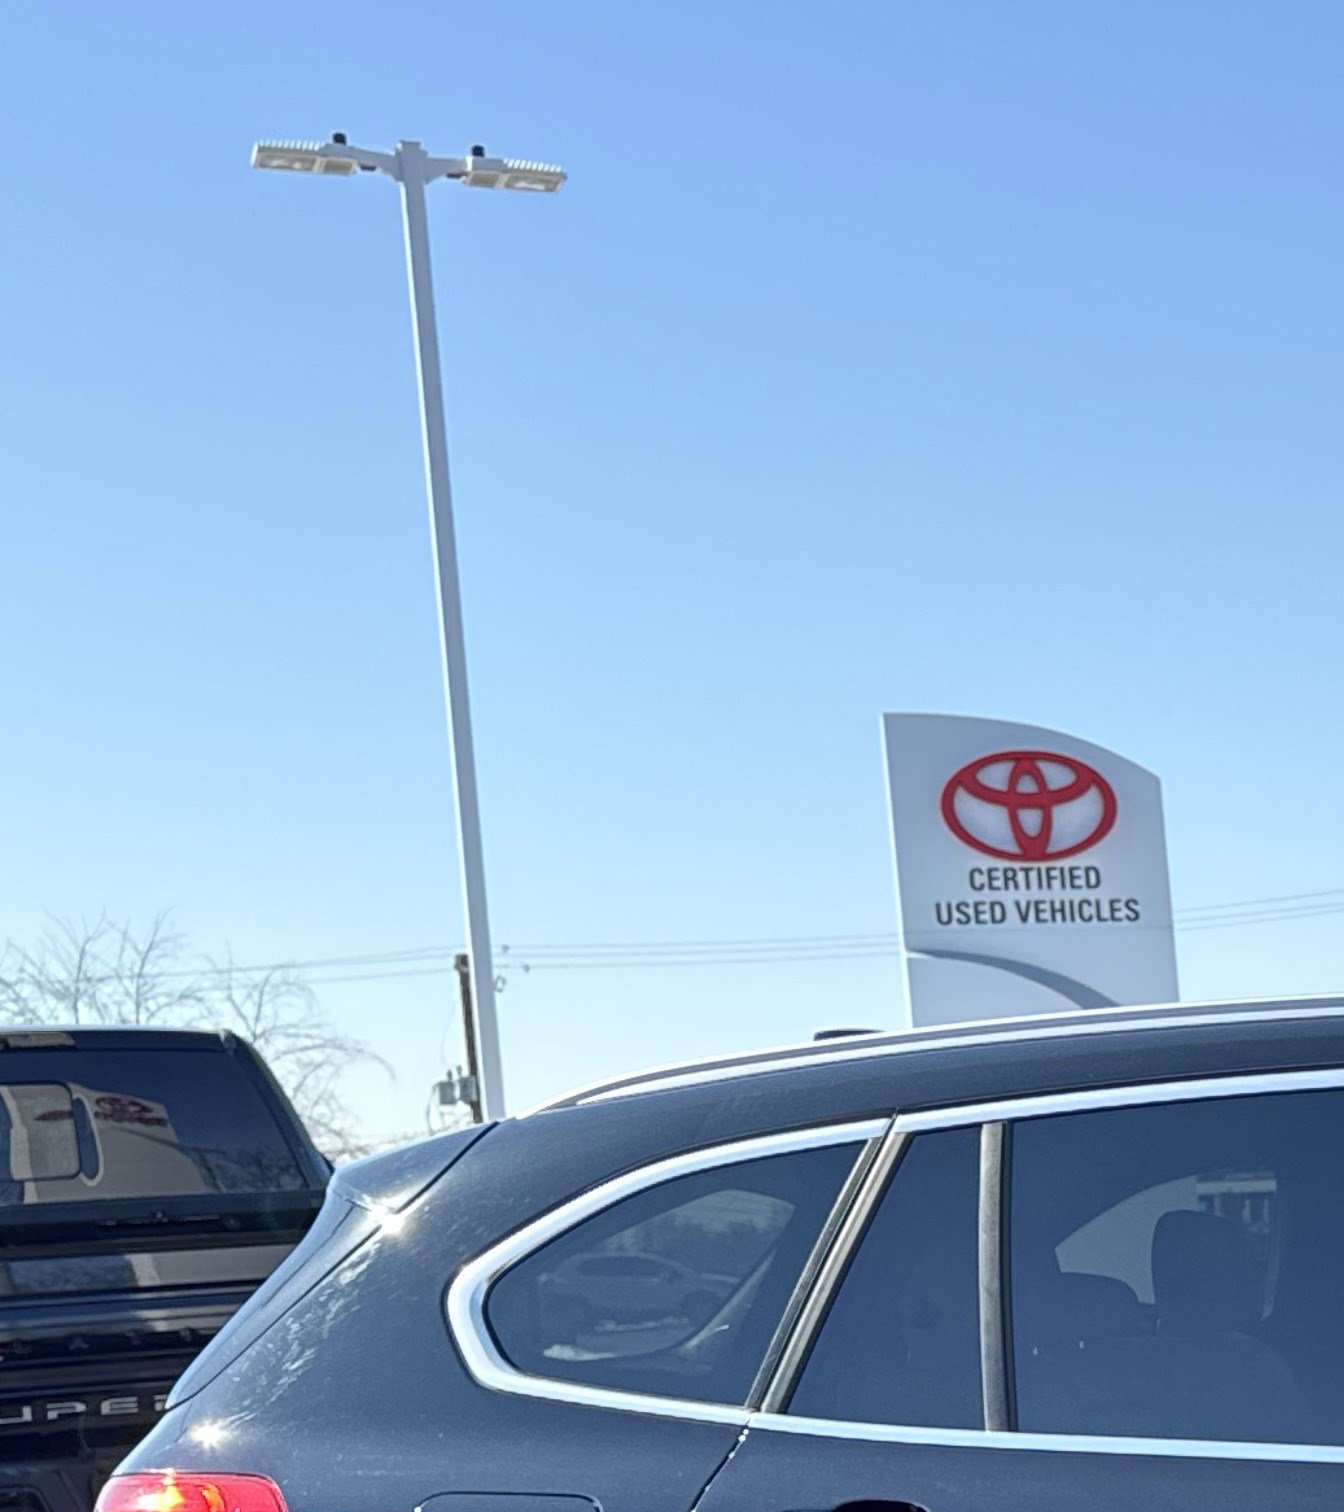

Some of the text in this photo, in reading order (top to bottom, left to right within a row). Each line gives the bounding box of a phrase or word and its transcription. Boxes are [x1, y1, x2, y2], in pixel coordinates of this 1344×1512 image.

[968, 865, 1102, 892] CERTIFIED
[935, 898, 1141, 926] USED VEHICLES
